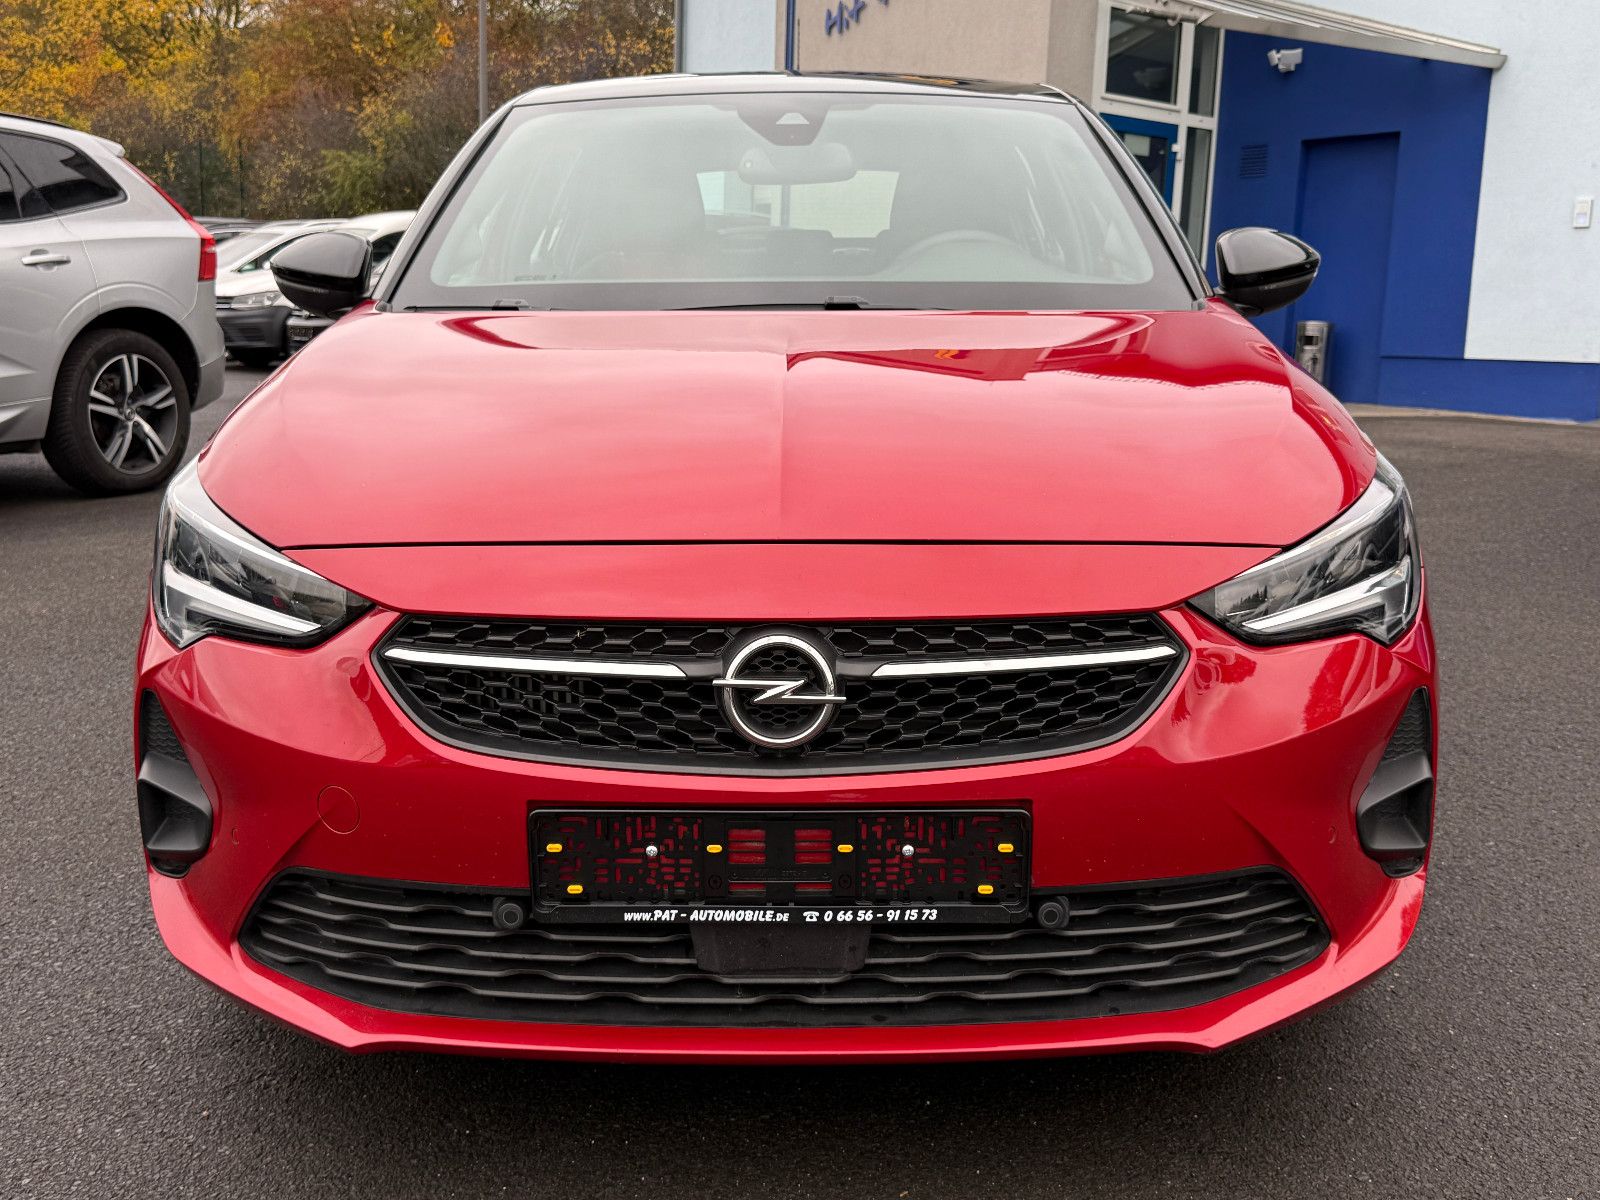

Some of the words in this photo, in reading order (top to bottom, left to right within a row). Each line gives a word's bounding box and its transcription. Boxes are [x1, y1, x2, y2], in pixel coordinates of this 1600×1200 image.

[823, 910, 834, 922] 0
[836, 910, 854, 922] 66
[856, 910, 874, 922] 56
[886, 909, 901, 922] 91
[904, 909, 919, 921] 15
[921, 908, 938, 921] 73
